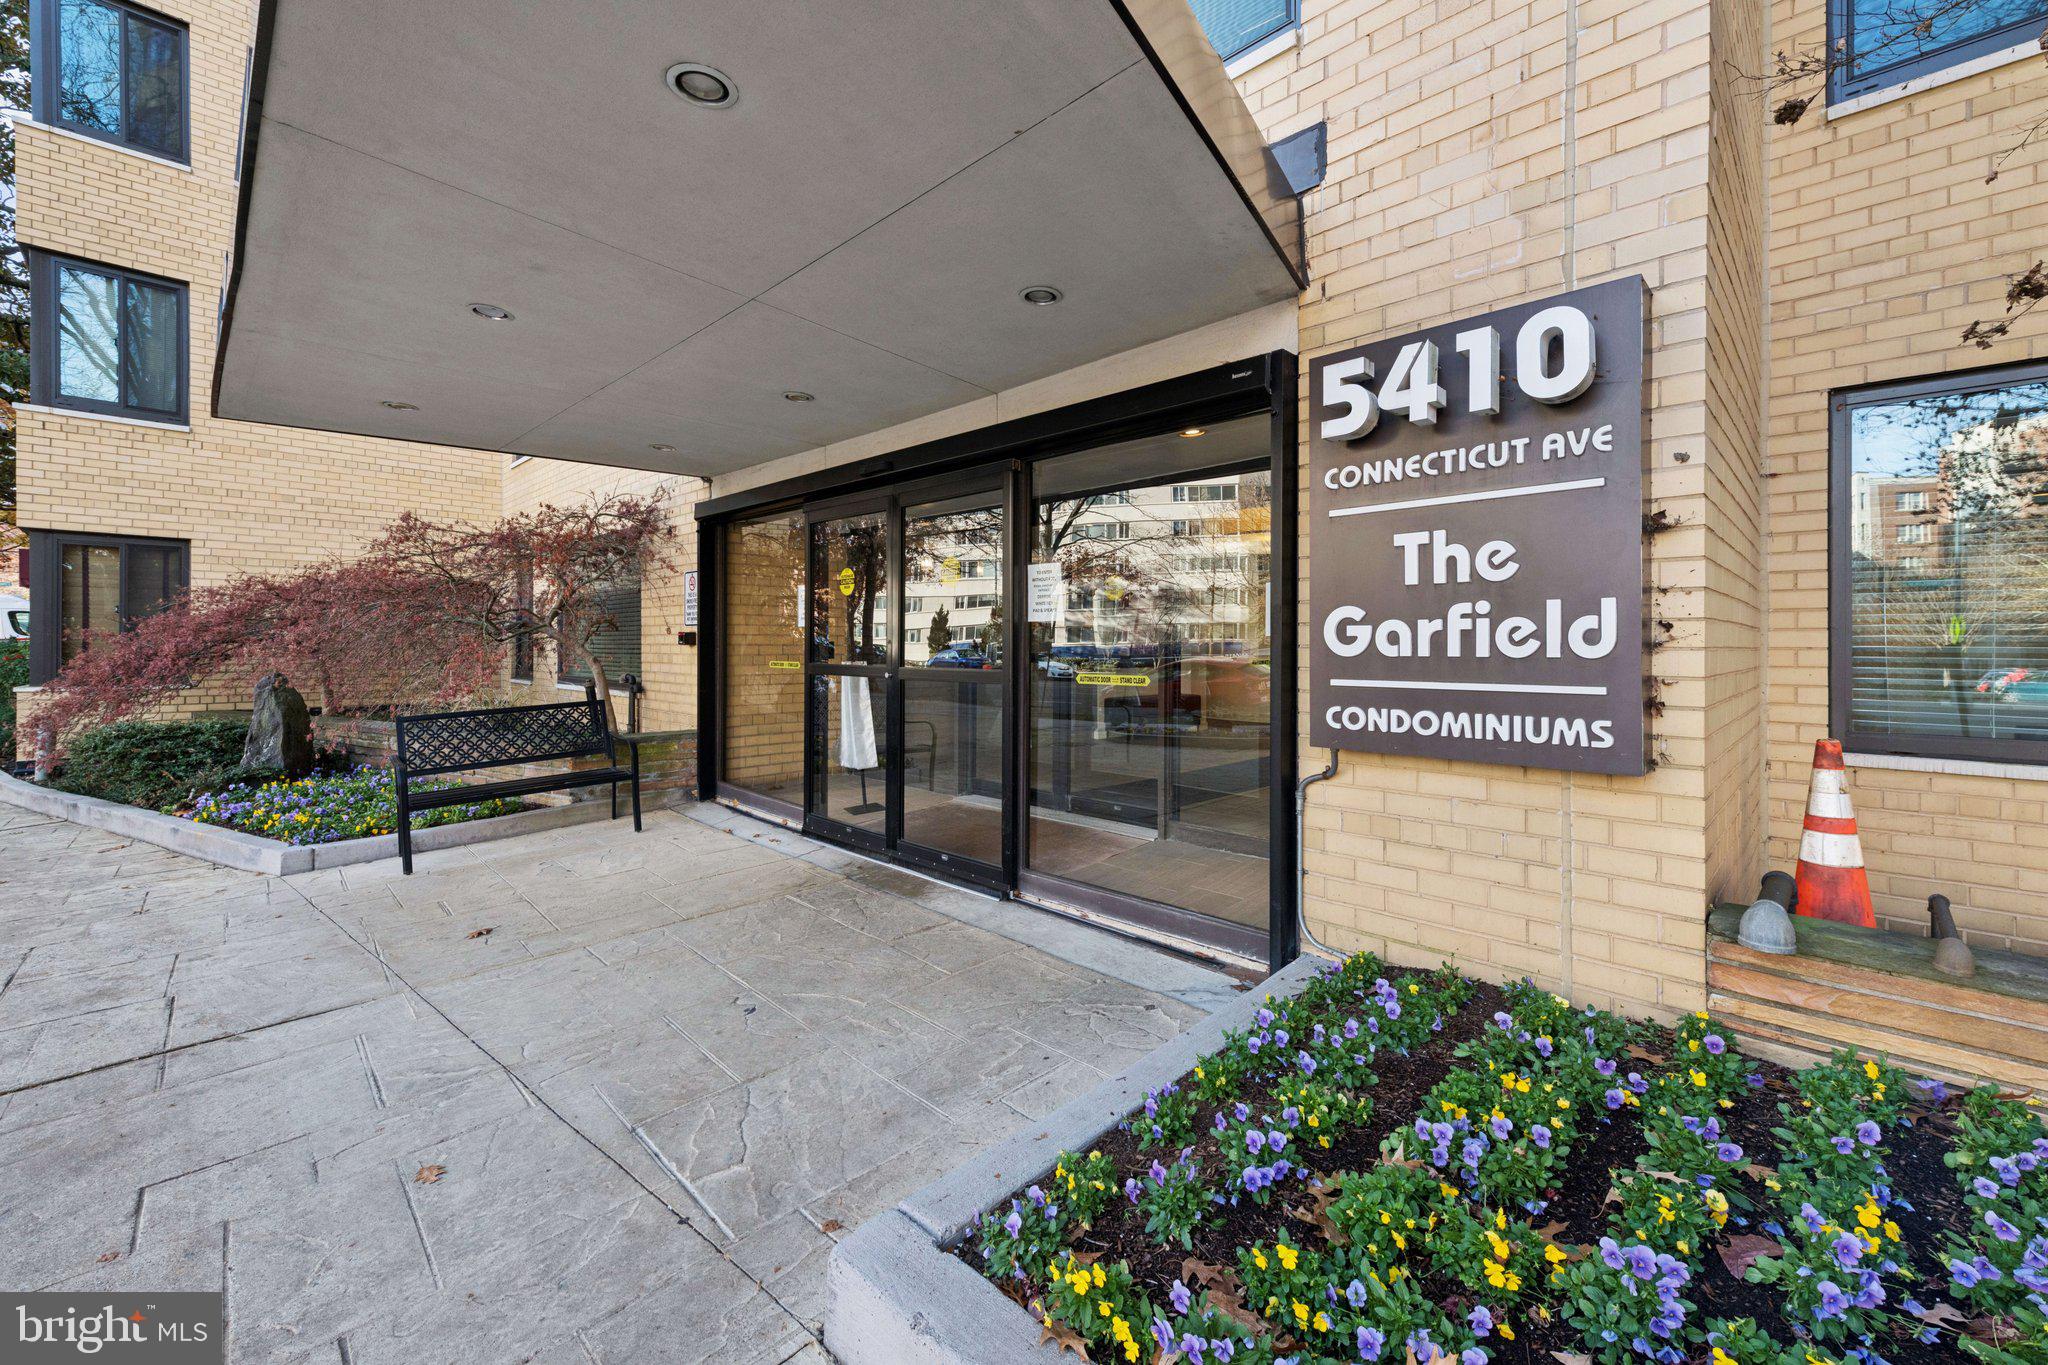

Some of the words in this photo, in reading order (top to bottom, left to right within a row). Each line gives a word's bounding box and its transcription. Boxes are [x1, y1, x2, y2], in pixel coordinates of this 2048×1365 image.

[1321, 305, 1596, 441] 5410
[1324, 437, 1530, 490] CONNECTICUT
[1543, 424, 1613, 461] AVE
[1393, 530, 1521, 586] The
[1323, 597, 1618, 659] Garfield
[1325, 705, 1615, 749] CONDOMINIUMS
